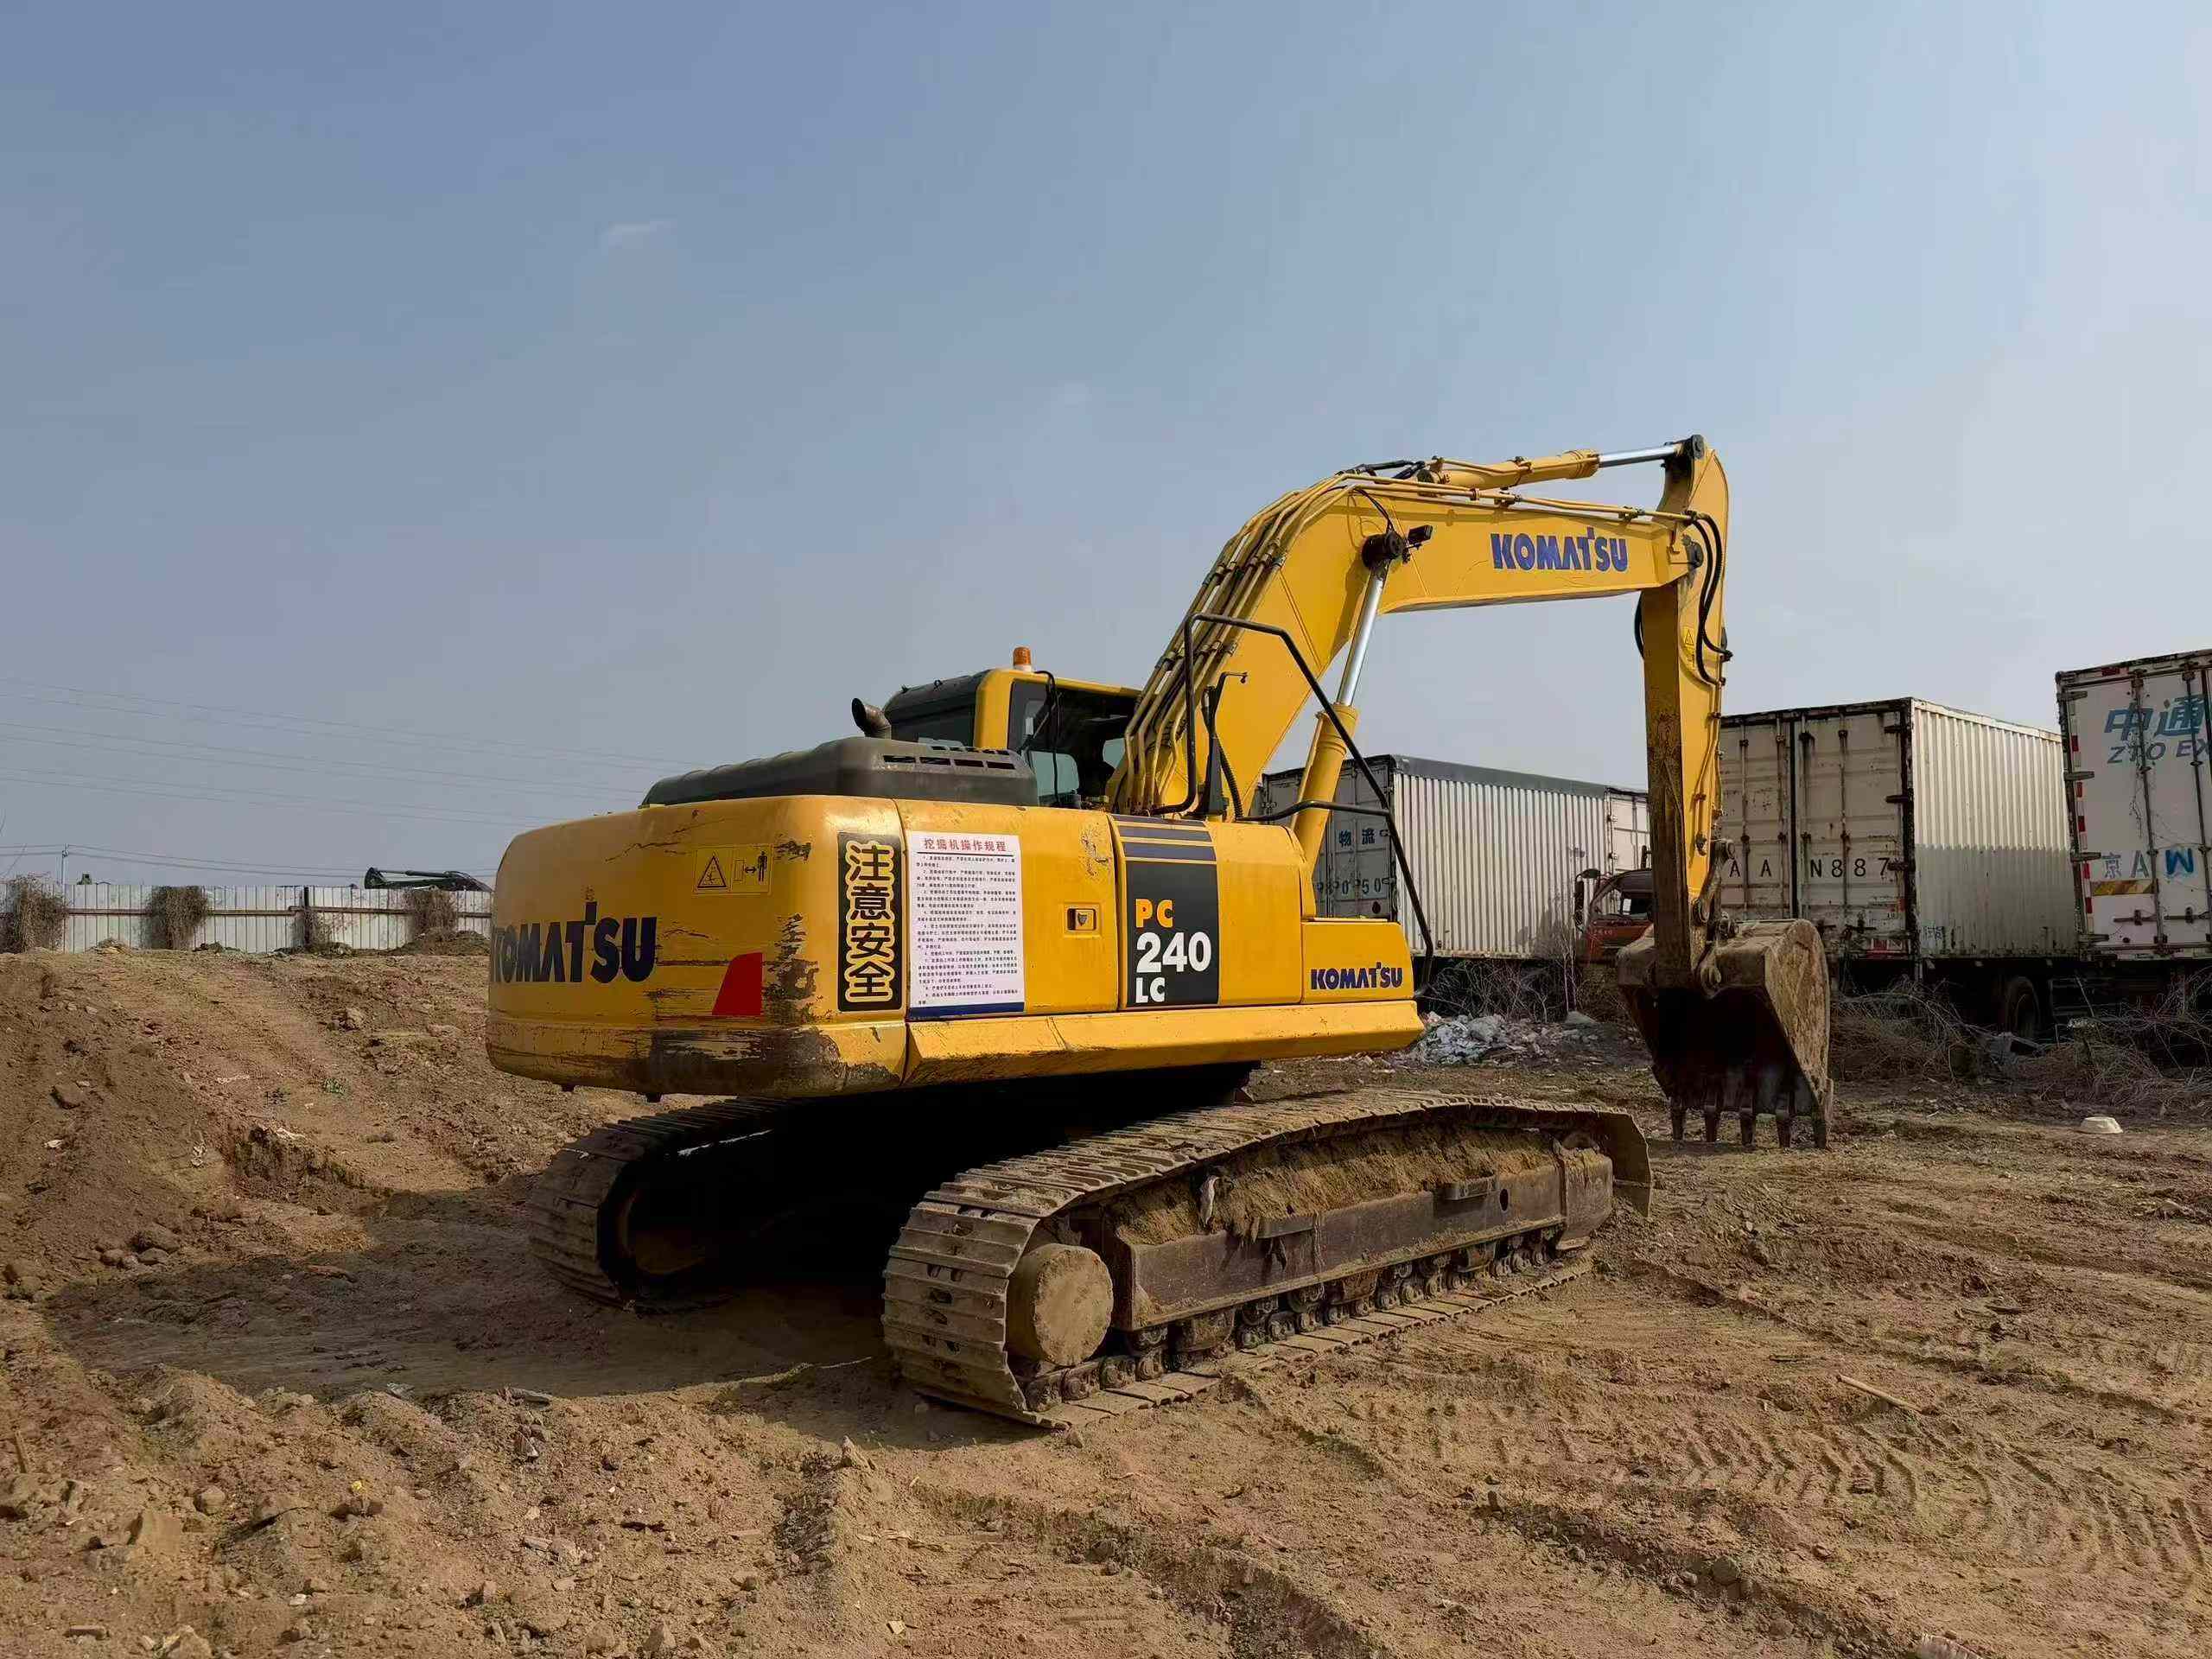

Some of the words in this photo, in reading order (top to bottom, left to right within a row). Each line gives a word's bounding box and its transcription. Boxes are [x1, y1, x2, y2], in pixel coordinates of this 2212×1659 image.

[1491, 526, 1629, 571] KOMATSU
[2104, 695, 2206, 741] 中通
[924, 838, 1007, 853] 挖掘机操作规程
[1339, 828, 1376, 847] 物流
[846, 841, 895, 1002] 注意安全
[1135, 899, 1174, 928] PC
[1136, 932, 1211, 974] 240
[1135, 977, 1166, 1004] LC
[1311, 962, 1403, 991] KOMATSU
